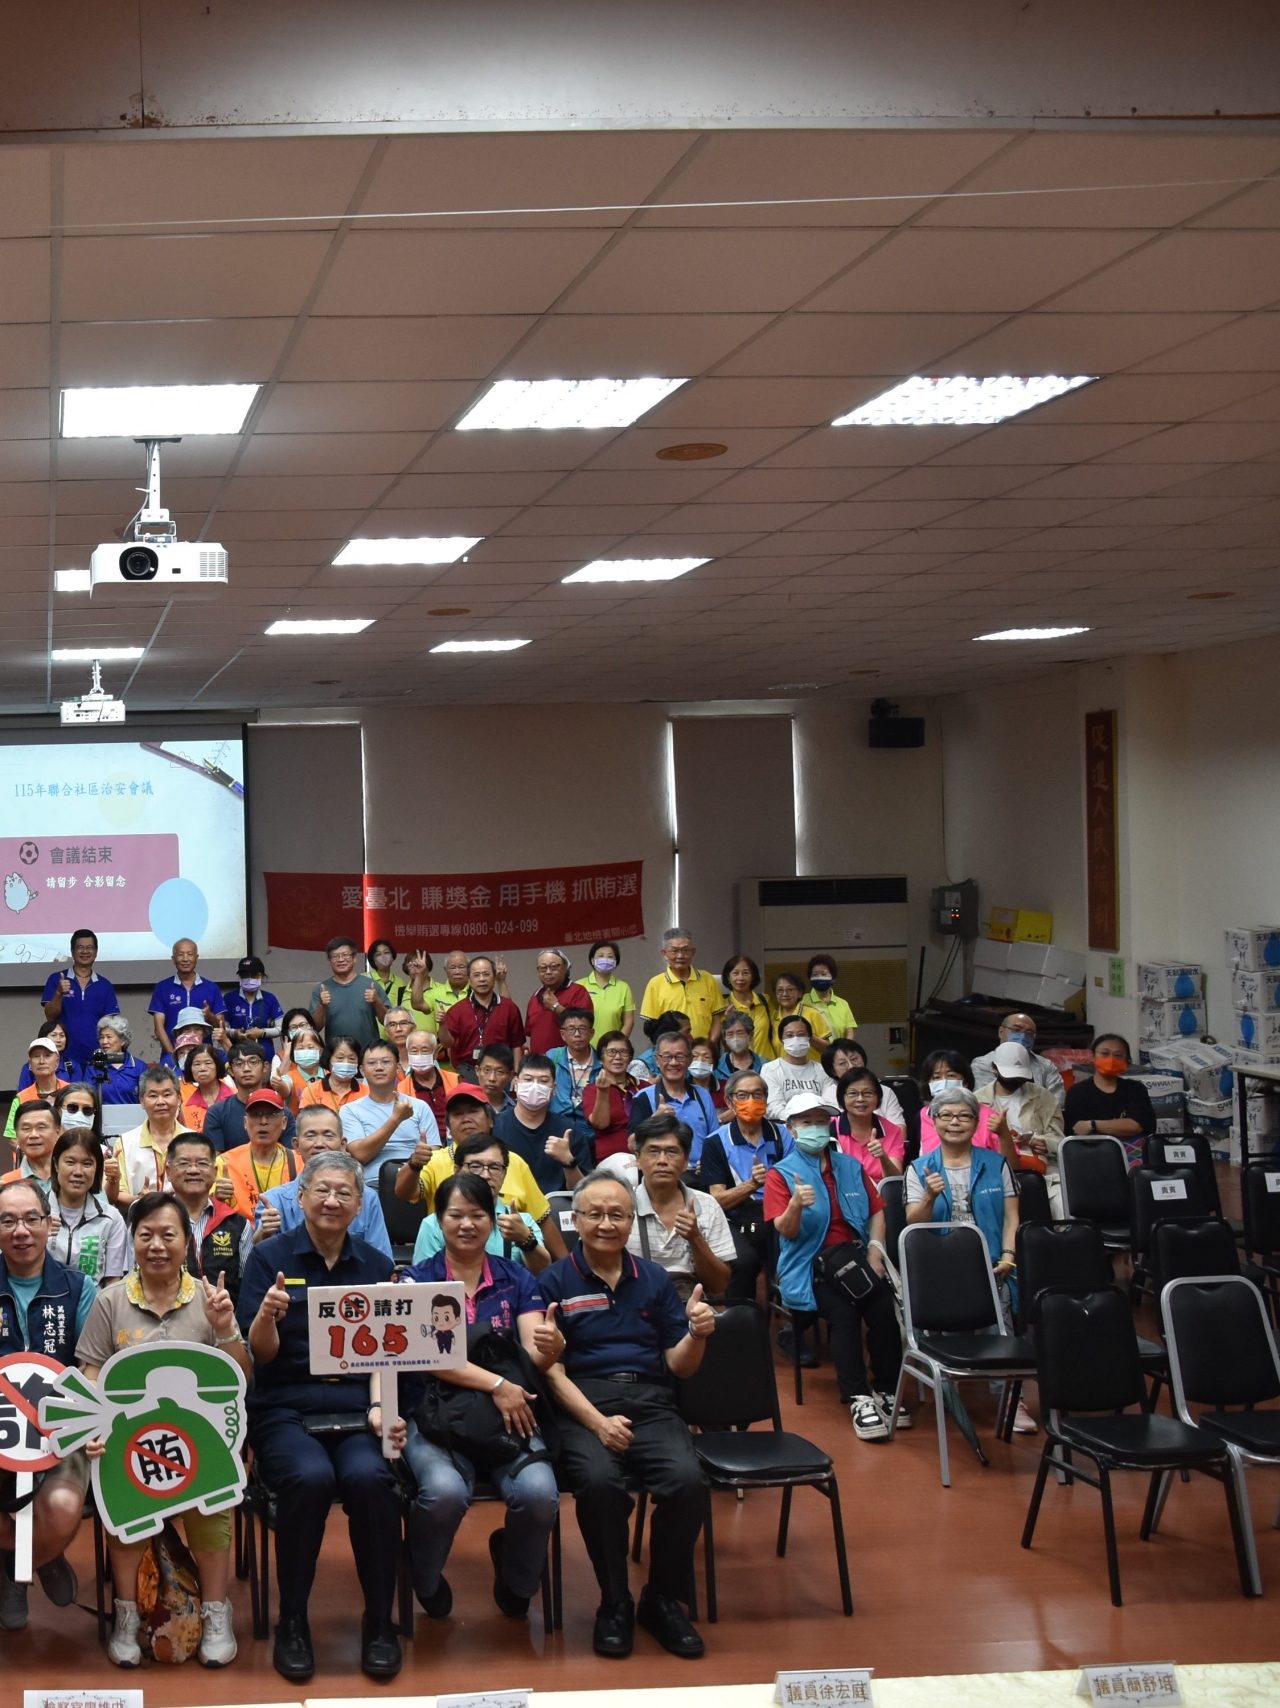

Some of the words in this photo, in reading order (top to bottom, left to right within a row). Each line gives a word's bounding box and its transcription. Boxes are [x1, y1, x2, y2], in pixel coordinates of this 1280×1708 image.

[14, 782, 155, 798] 115年聯合社區治安會議
[49, 846, 113, 865] 會議結束
[46, 876, 77, 889] 請留步
[83, 875, 127, 888] 合影留念
[341, 885, 411, 911] 愛臺北
[421, 885, 492, 911] 賺獎金
[499, 880, 566, 907] 用手機
[571, 873, 637, 902] 抓賄選
[41, 1304, 57, 1353] 林志冠
[57, 1305, 66, 1345] 萬興里里長
[327, 1323, 409, 1358] 165
[134, 1434, 186, 1485] 賄
[787, 1682, 865, 1701] 議員徐宏庭
